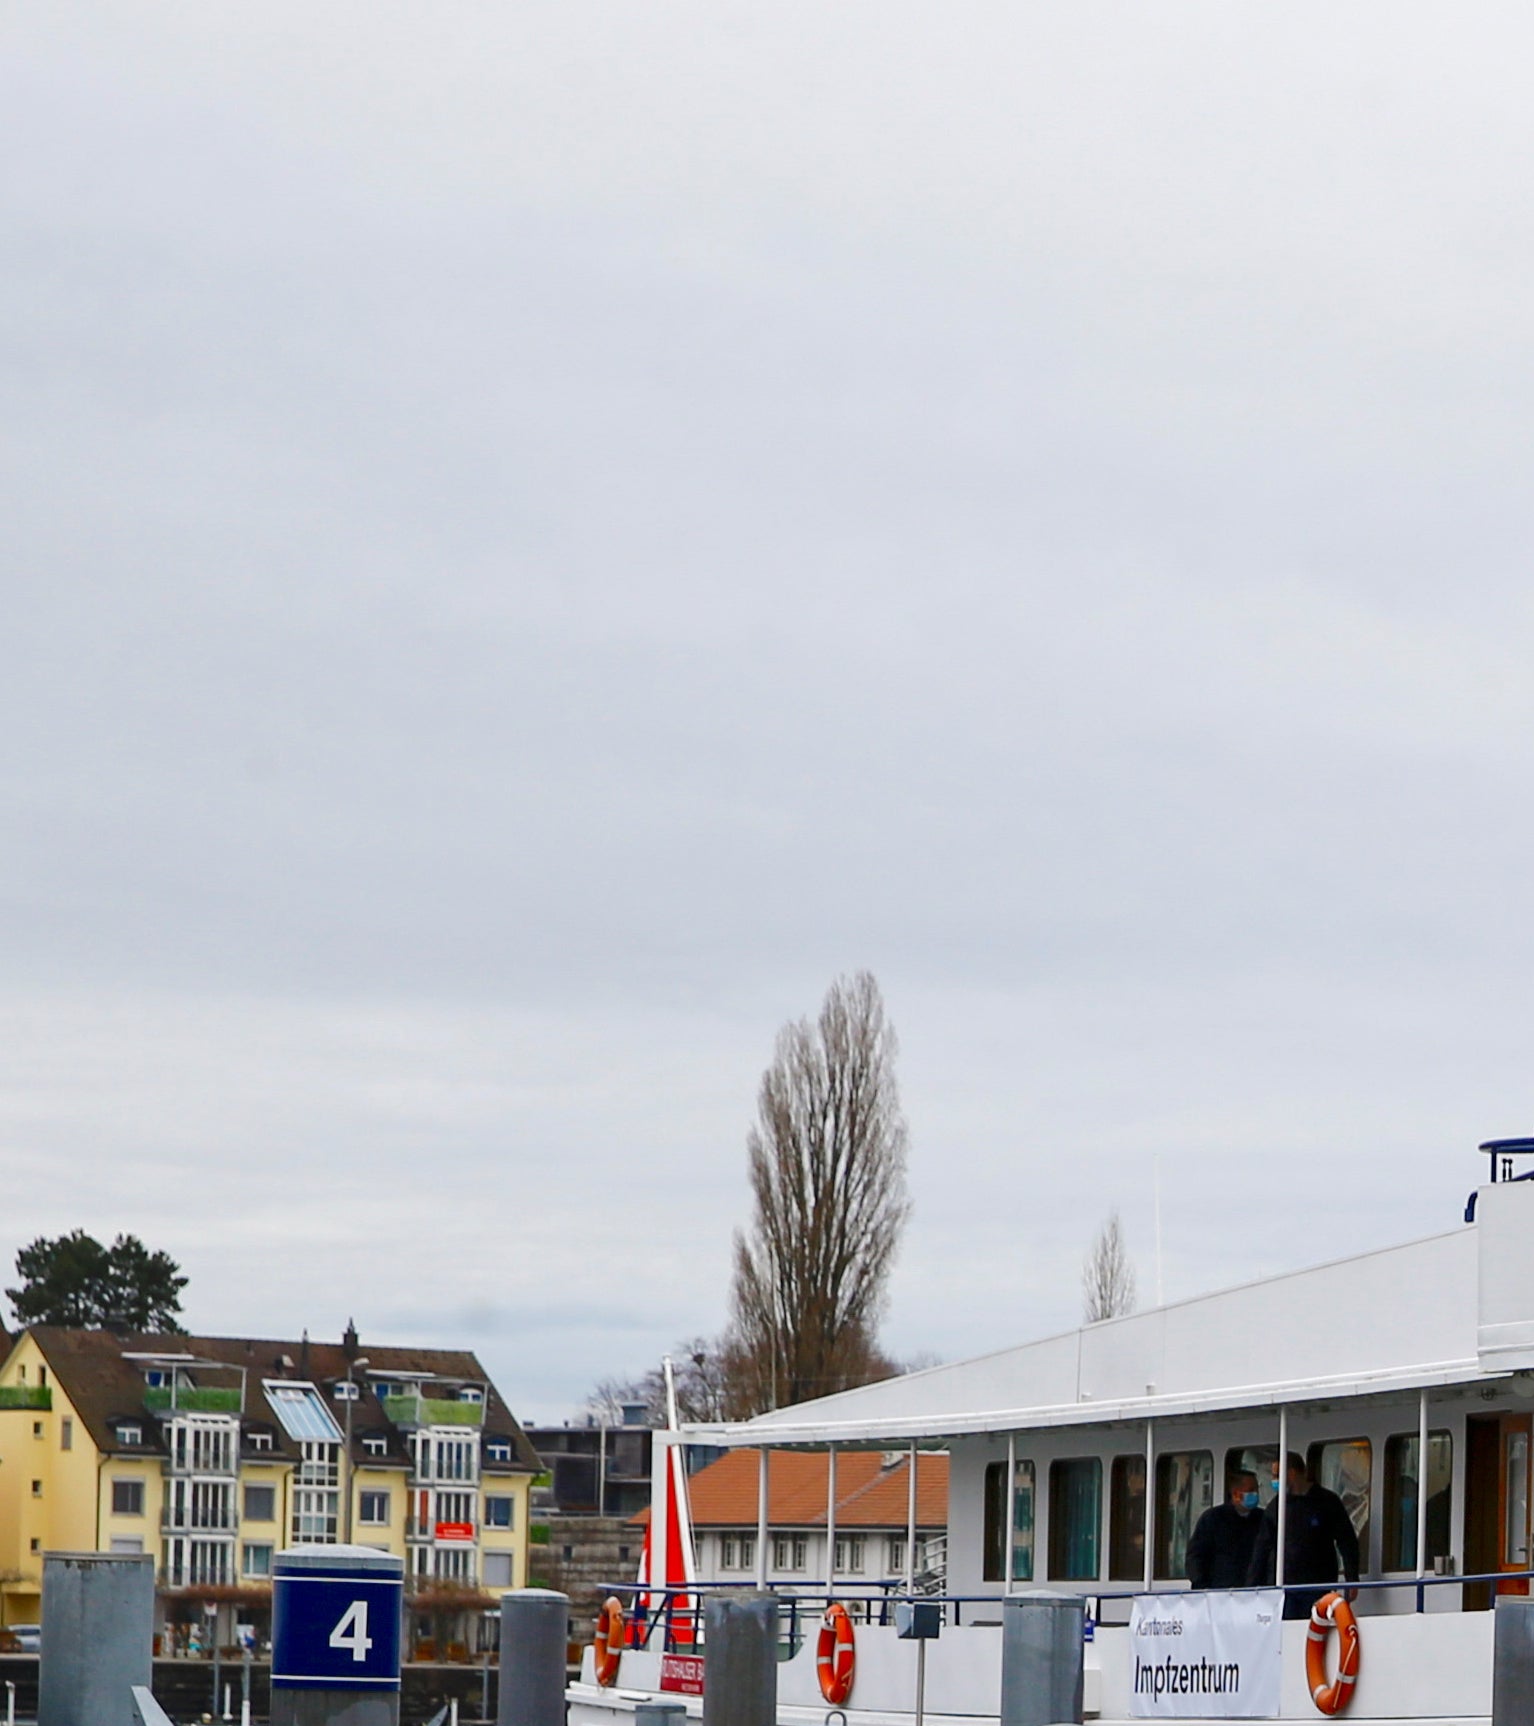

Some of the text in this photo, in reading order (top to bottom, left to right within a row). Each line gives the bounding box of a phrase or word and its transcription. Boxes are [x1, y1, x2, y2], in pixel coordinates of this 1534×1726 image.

[329, 1600, 373, 1662] 4
[1136, 1616, 1183, 1636] Kantonales
[1134, 1655, 1239, 1702] Impfzentrum
